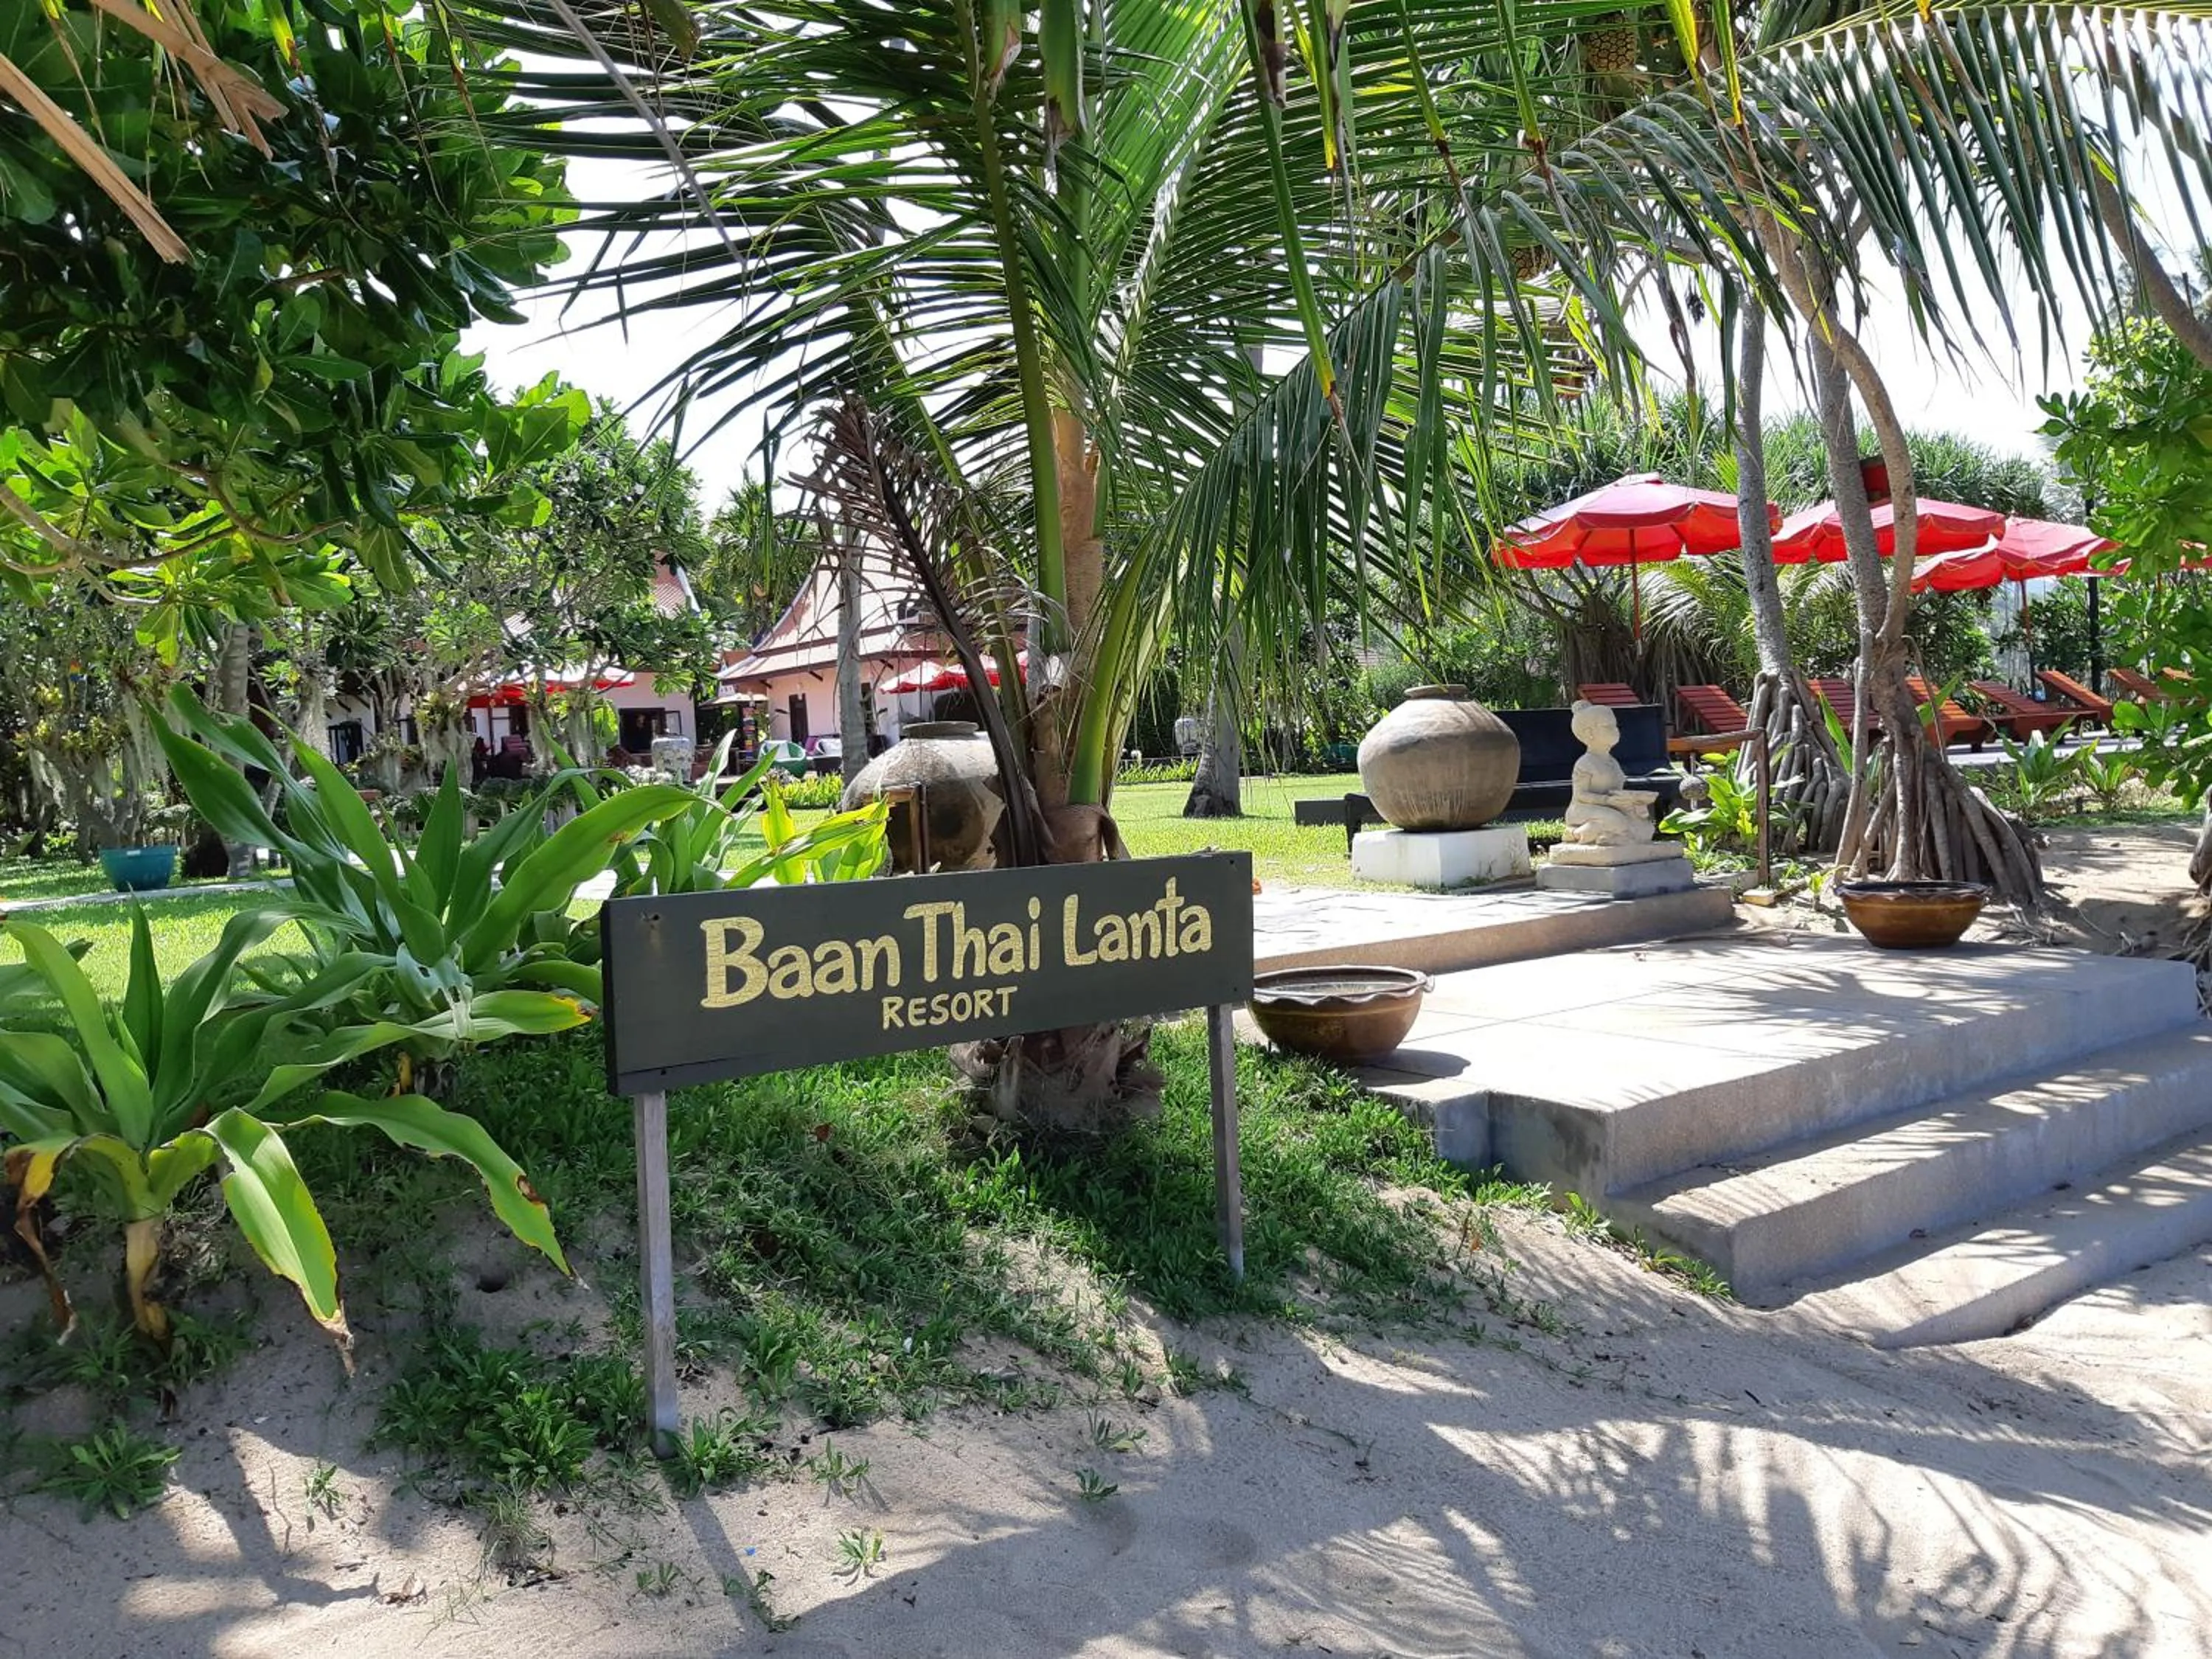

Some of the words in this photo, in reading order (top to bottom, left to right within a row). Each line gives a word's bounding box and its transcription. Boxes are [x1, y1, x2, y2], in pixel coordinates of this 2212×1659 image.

[700, 917, 900, 1008] Baan
[904, 897, 1040, 982] Thai
[1063, 877, 1211, 966] Lanta
[882, 986, 1018, 1030] RESORT
